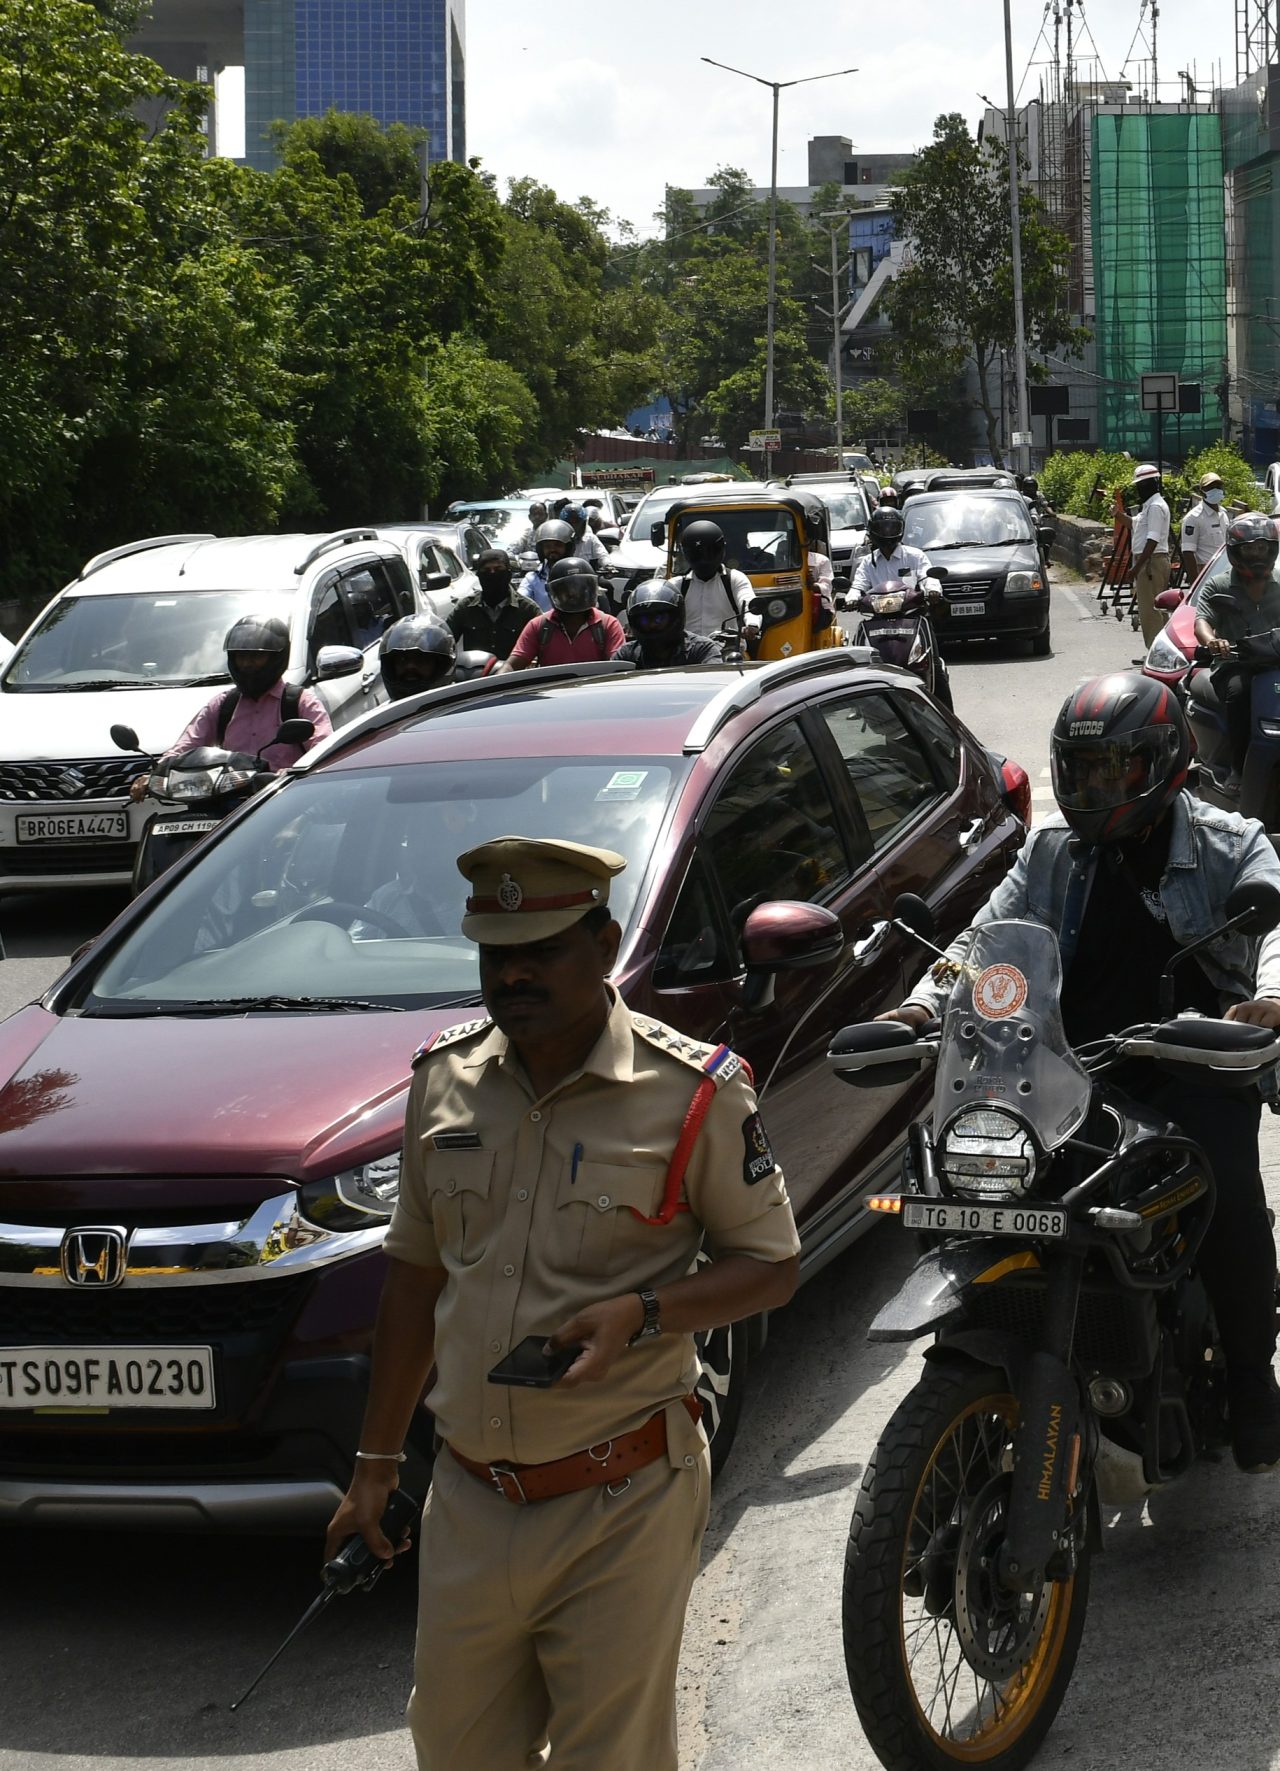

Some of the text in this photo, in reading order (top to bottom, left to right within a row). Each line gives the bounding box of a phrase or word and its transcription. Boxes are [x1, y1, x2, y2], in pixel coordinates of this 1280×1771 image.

[1069, 720, 1105, 737] STUDDS
[28, 818, 125, 836] BR06EA4479
[925, 1208, 1062, 1233] TG 10 E 0068
[0, 1358, 205, 1397] TS09FA0230
[1037, 1404, 1062, 1500] HIMALAYAN
